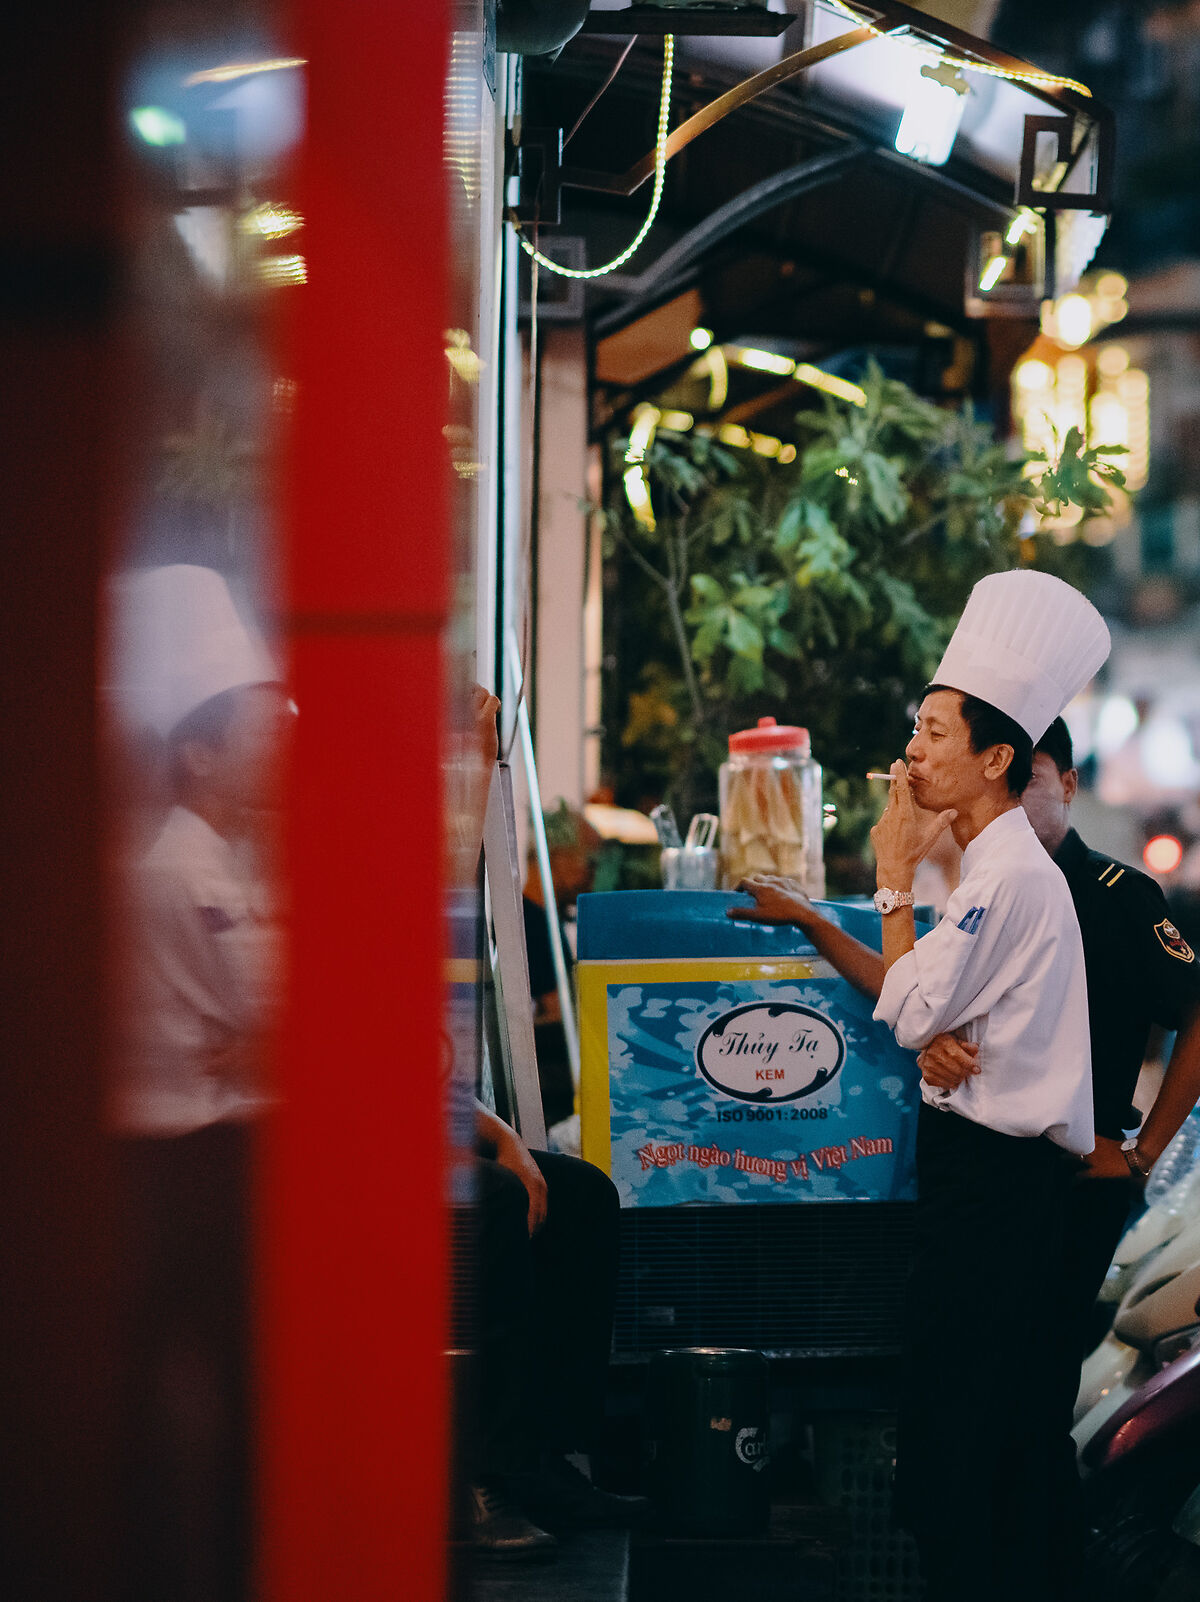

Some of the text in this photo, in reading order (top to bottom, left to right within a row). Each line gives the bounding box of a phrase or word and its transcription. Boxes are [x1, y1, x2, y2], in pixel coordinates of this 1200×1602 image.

[719, 1029, 819, 1064] Thủy Tạ
[755, 1069, 785, 1080] KEM
[717, 1107, 828, 1122] ISO 9001:2008
[637, 1142, 685, 1171] Ngọt
[688, 1142, 731, 1168] ngào
[790, 1153, 809, 1180] vị
[810, 1145, 848, 1171] Việt
[849, 1135, 893, 1160] Nam
